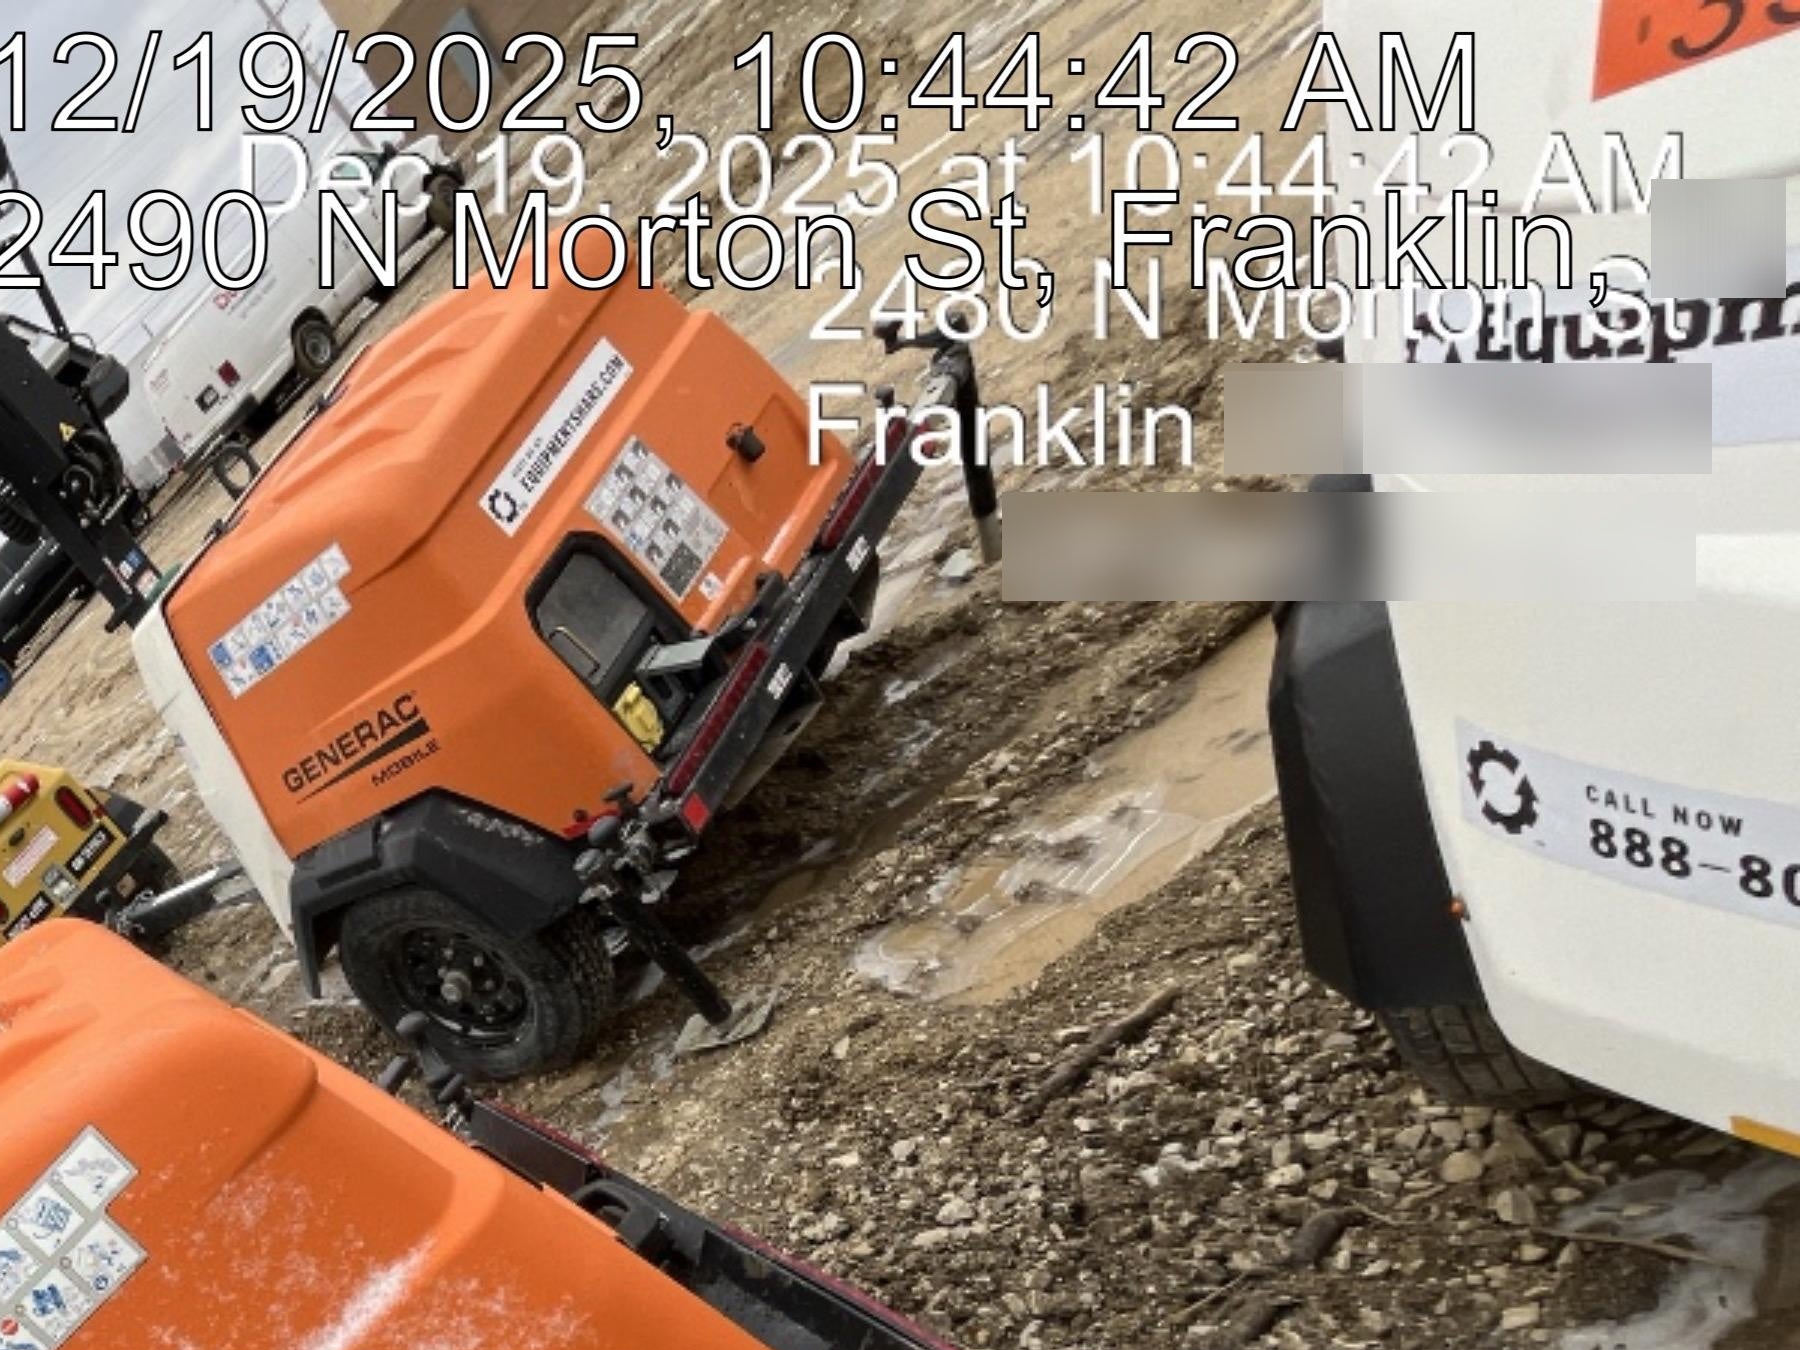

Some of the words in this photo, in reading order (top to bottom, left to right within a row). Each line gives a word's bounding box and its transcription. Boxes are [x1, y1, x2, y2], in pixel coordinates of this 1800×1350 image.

[282, 693, 420, 793] GENERAC
[371, 738, 441, 787] MOBILE
[1585, 783, 1657, 819] CALL
[1673, 803, 1746, 839] NOW
